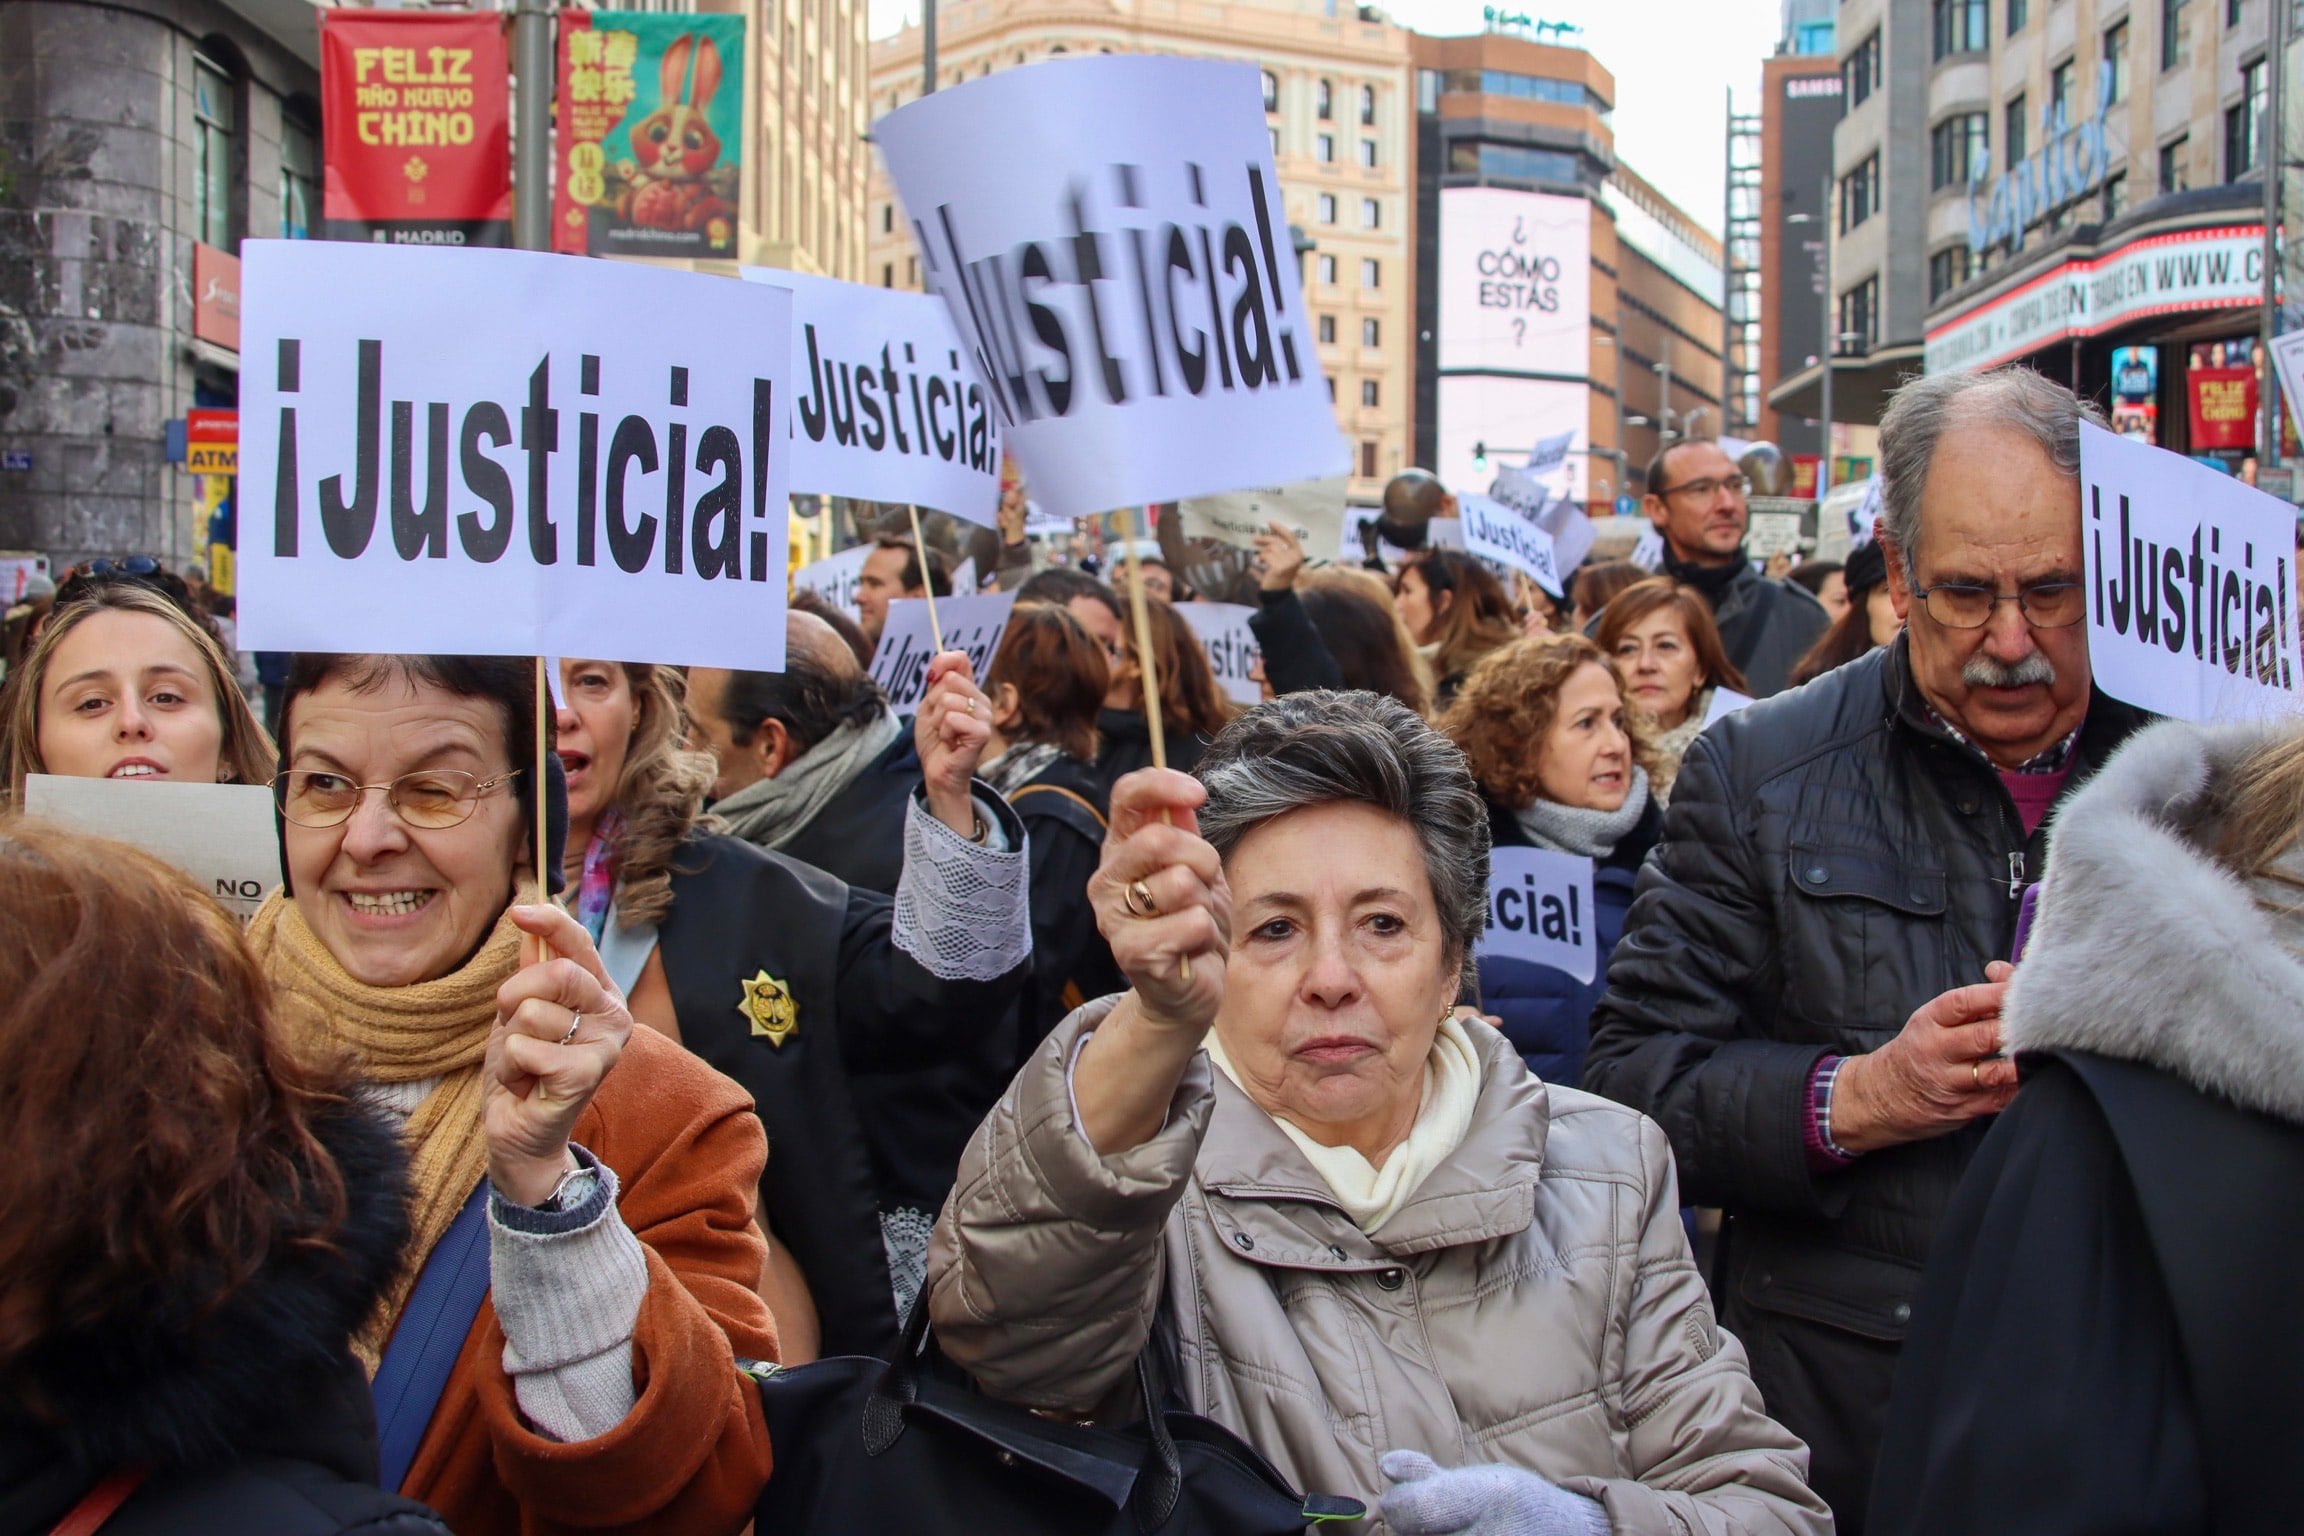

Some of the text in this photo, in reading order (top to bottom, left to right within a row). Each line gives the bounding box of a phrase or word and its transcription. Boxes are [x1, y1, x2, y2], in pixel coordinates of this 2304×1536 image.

[354, 47, 473, 83] FELIZ
[356, 83, 473, 109] AÑO NUEVO
[358, 110, 474, 146] CHINO
[1968, 59, 2111, 253] Capitol
[395, 230, 466, 245] MADRID
[1478, 247, 1560, 282] CÓMO
[1480, 275, 1558, 312] ESTÁS
[790, 322, 996, 476] Justicia!
[191, 450, 238, 468] ATM
[274, 338, 772, 583] ¡Justicia!
[2091, 483, 2293, 692] ¡Justicia!
[216, 879, 262, 897] NO
